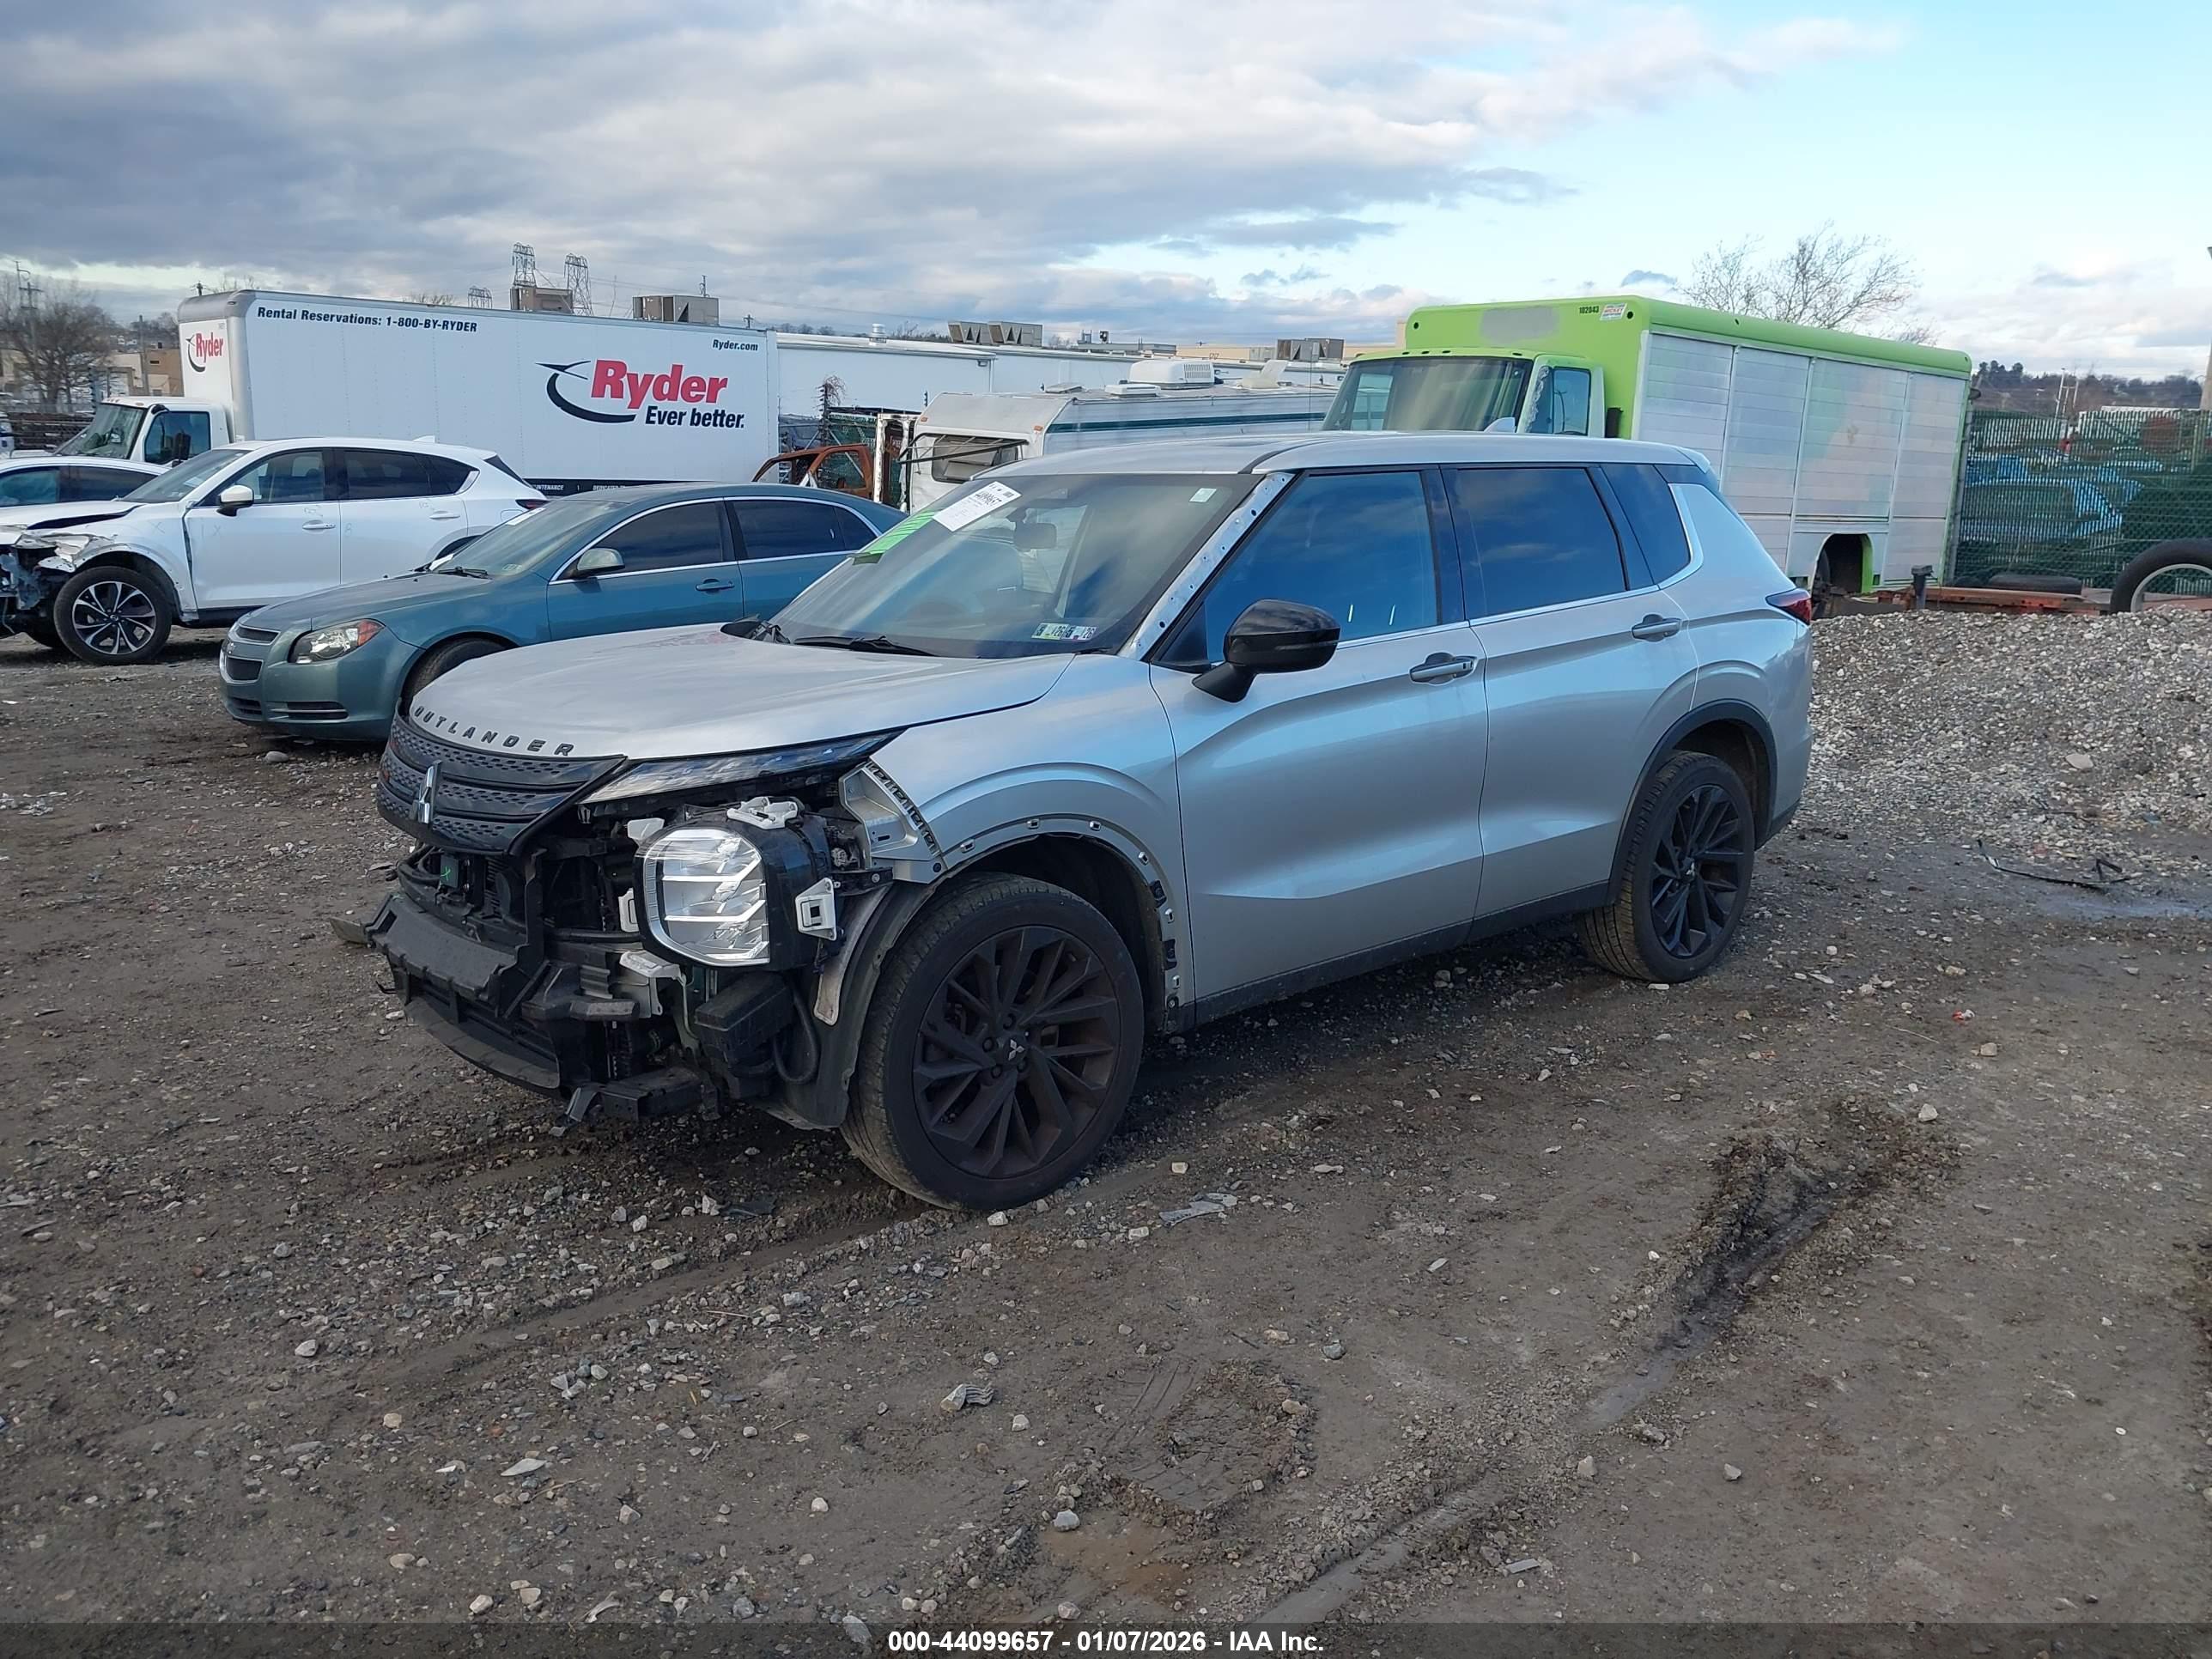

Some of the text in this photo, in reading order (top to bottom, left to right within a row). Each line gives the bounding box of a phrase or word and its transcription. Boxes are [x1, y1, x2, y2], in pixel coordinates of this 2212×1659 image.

[258, 307, 477, 333] Rental Reservations: 1-800-BY-RYDER
[196, 331, 224, 363] Ryder
[712, 338, 758, 351] Ryder.com
[591, 359, 728, 410] Ryder
[645, 405, 745, 428] Ever better.
[414, 705, 574, 757] OUTLANDER
